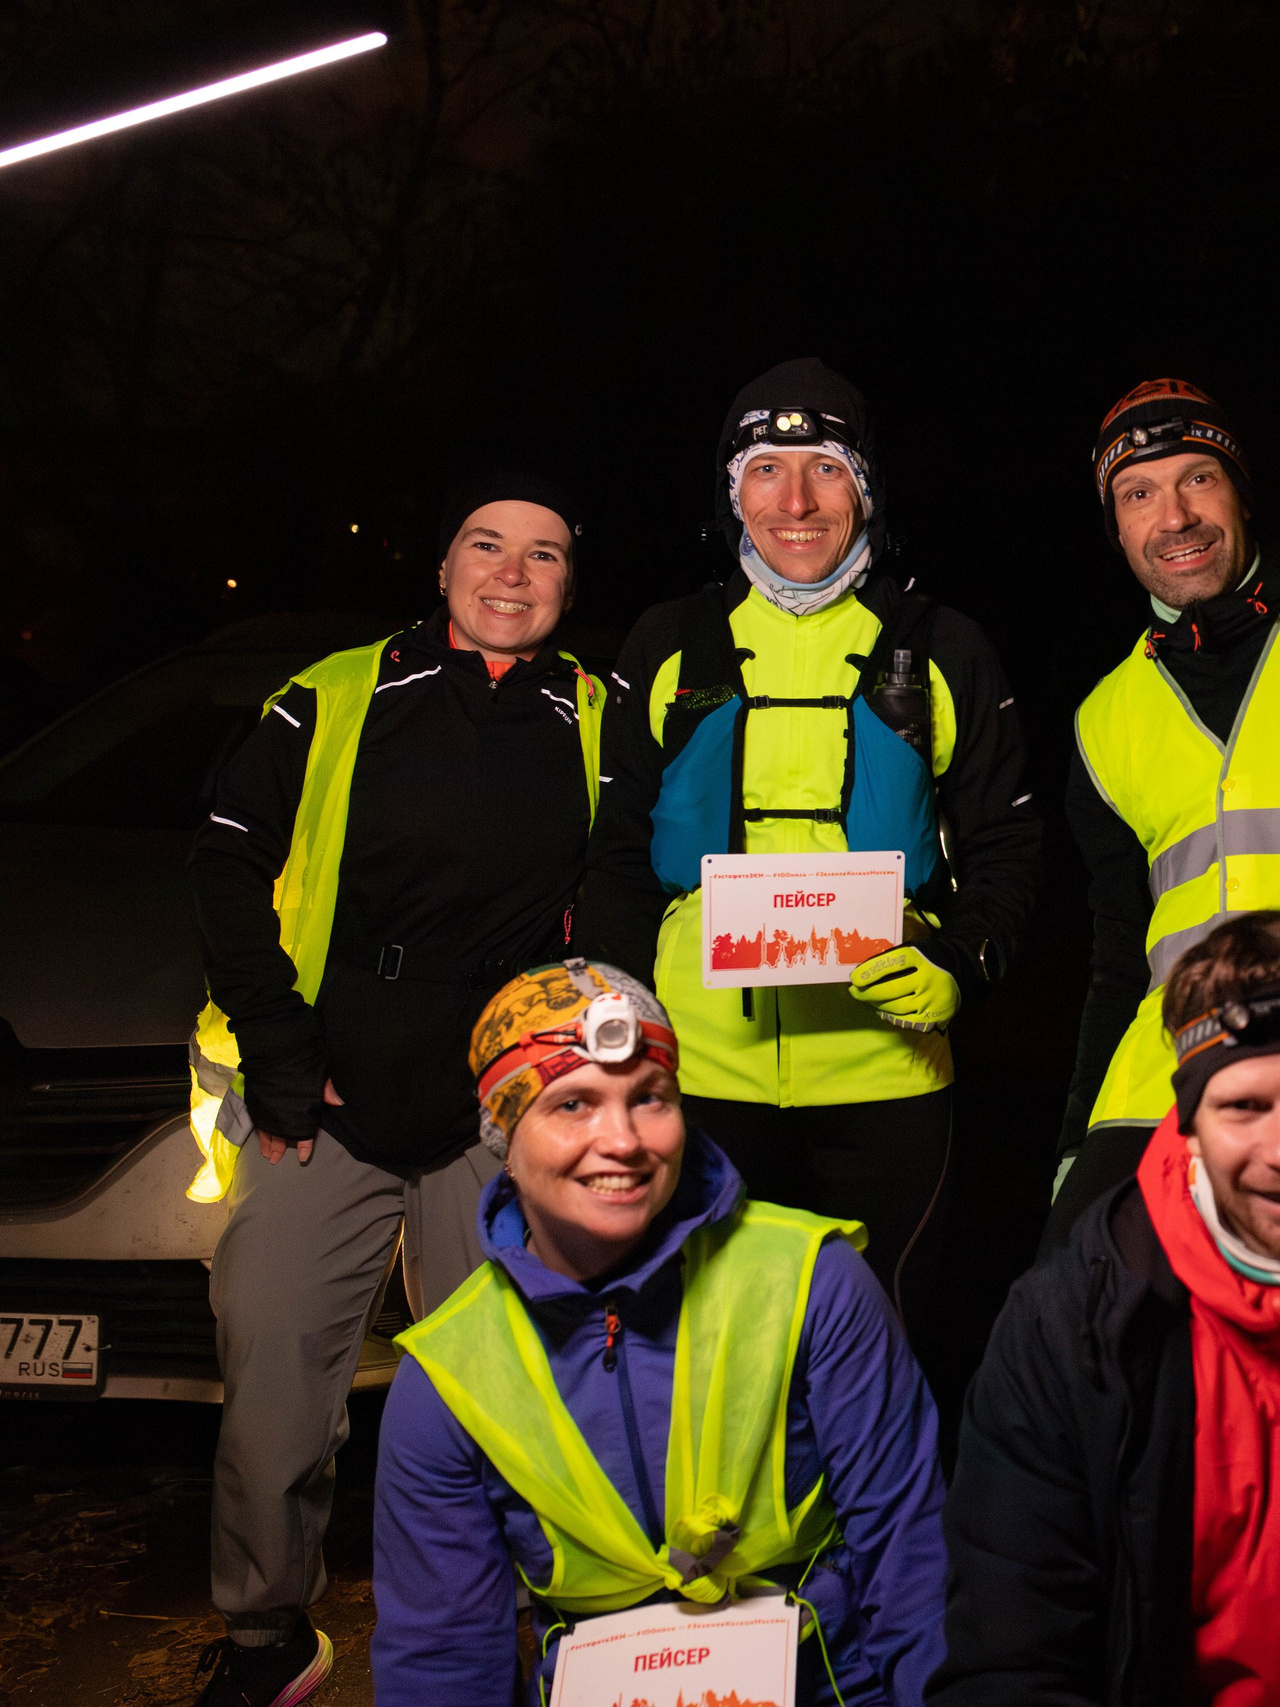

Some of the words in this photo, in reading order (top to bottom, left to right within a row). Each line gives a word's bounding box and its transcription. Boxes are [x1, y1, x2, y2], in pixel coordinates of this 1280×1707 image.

[753, 424, 769, 441] PET
[773, 890, 836, 908] ПЕЙСЕР
[0, 1317, 83, 1360] 777
[18, 1361, 60, 1377] RUS
[633, 1647, 711, 1673] ПЕЙСЕР
